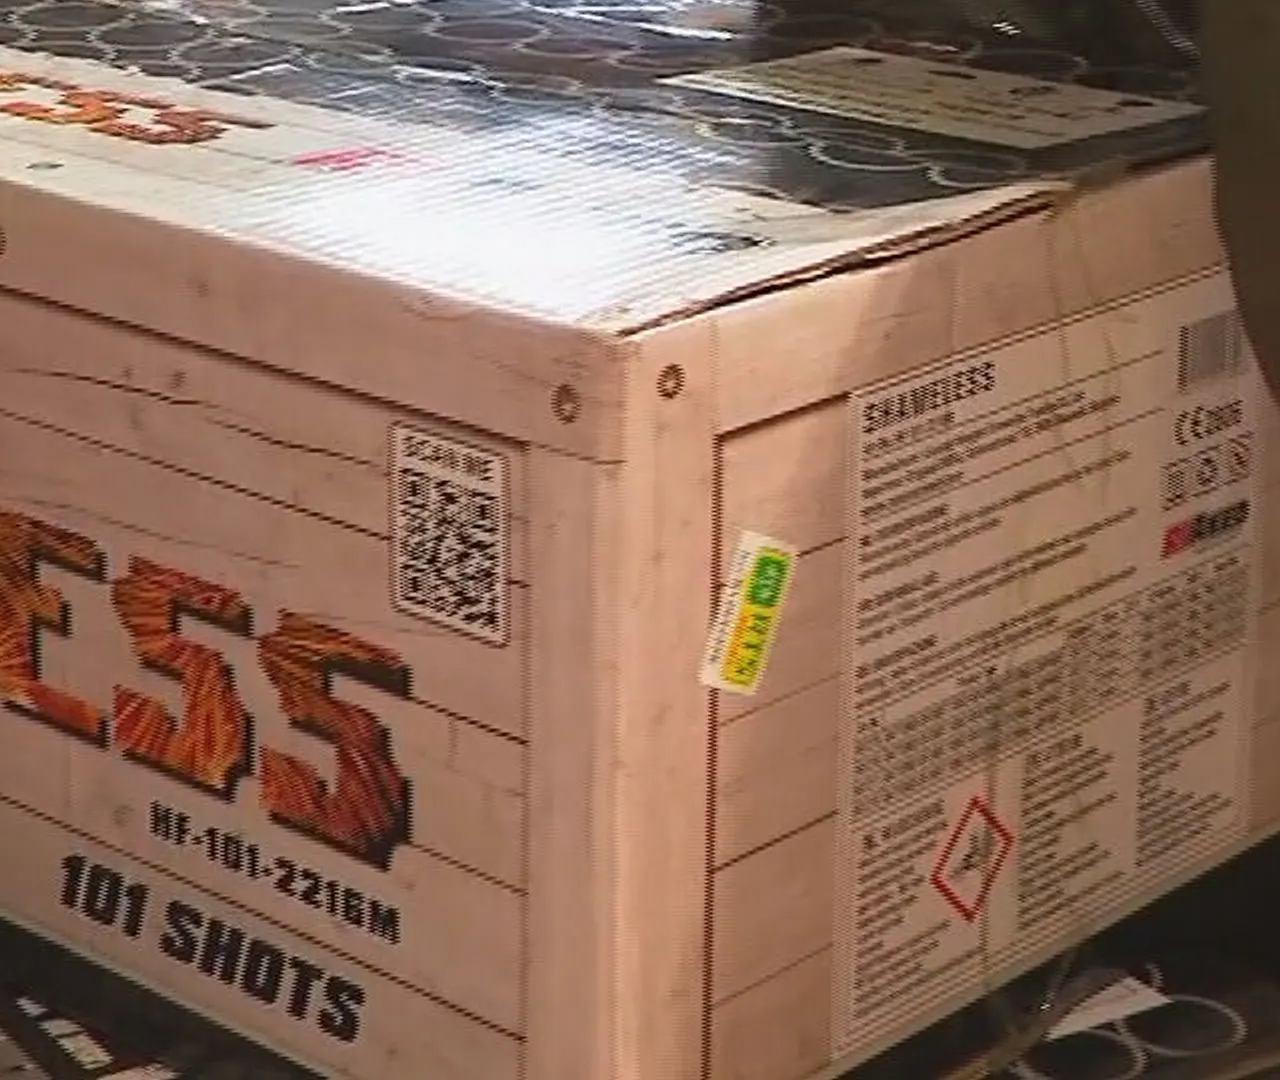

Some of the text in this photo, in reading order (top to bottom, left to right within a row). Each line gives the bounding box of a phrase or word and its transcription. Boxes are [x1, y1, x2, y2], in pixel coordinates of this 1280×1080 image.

[862, 361, 997, 434] SHAMELESS
[402, 435, 495, 482] SCAN ME
[61, 853, 368, 1044] 101 SHOTS
